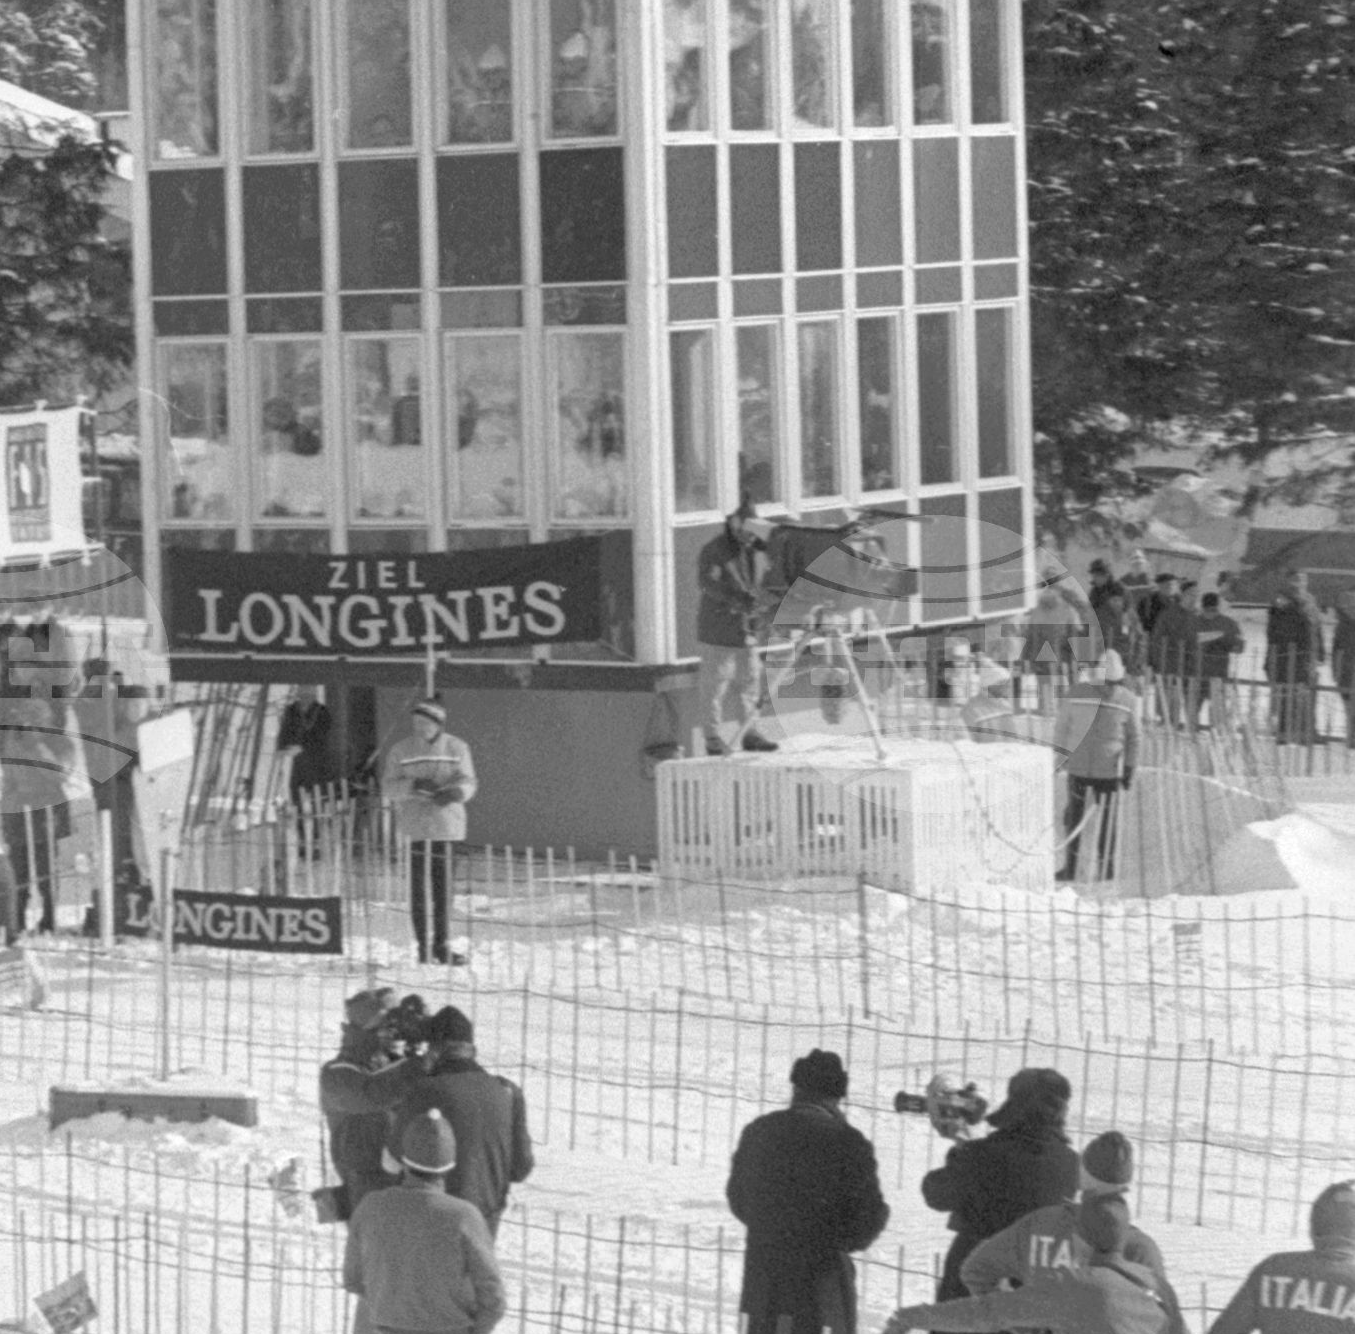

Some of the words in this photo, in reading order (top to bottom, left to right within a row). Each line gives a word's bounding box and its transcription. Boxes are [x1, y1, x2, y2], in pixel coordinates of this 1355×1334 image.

[328, 561, 425, 589] ZIEL
[197, 581, 566, 647] LONGINES
[1029, 1234, 1080, 1269] ITA
[1260, 1275, 1355, 1324] ITALIA
